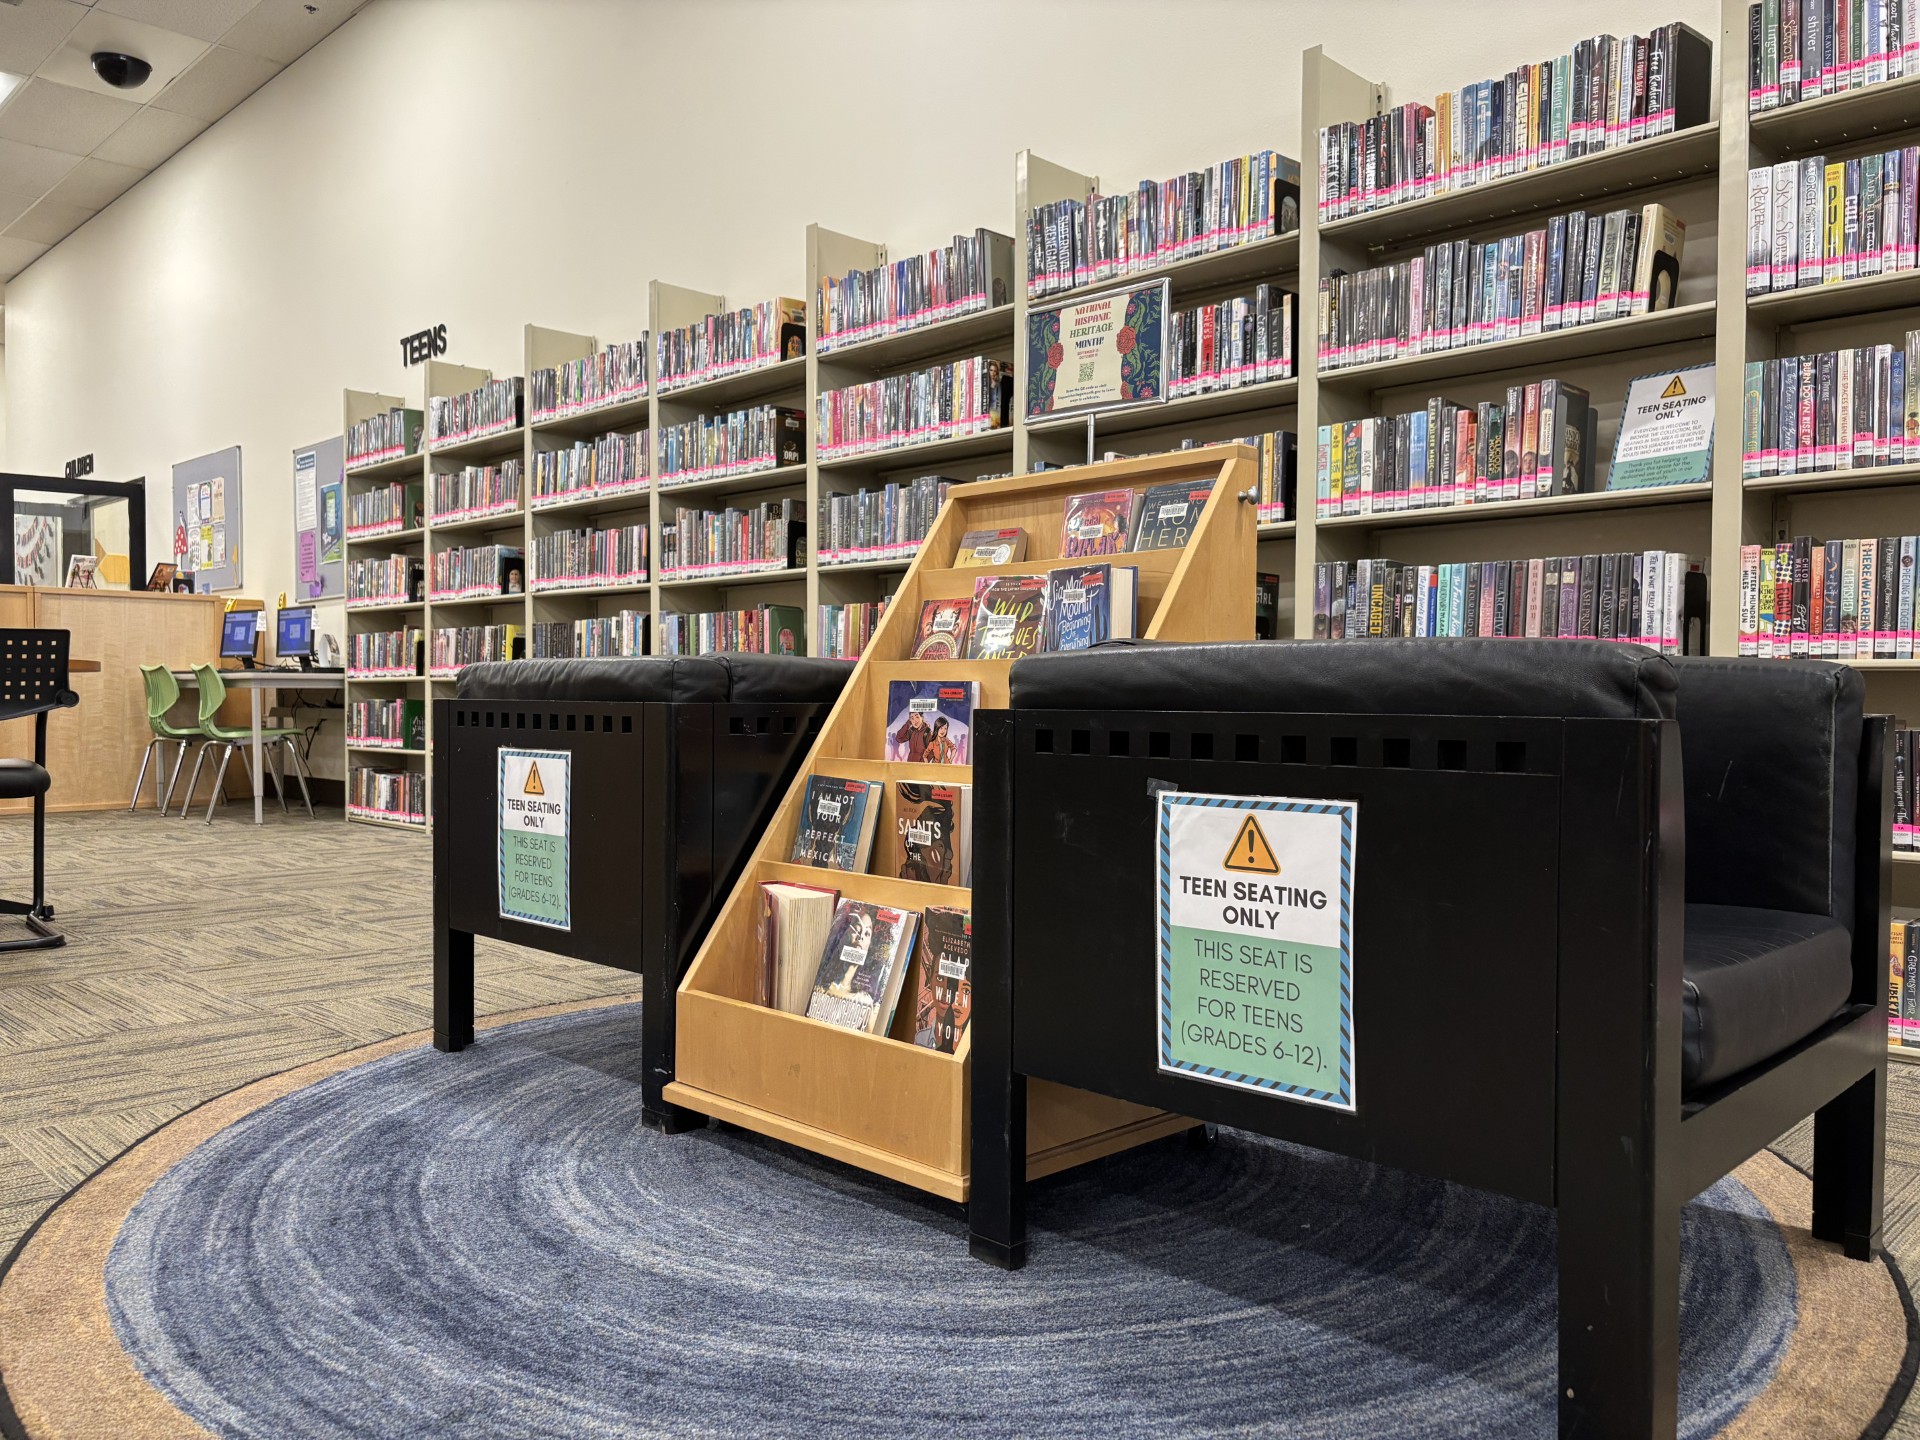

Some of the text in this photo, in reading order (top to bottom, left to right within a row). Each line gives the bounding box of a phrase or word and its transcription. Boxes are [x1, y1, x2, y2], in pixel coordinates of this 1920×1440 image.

[1752, 7, 1760, 46] LAMENT
[1807, 16, 1819, 51] shiver
[1764, 24, 1778, 58] linger
[1648, 49, 1663, 113] Free Radicals
[1776, 180, 1793, 208] SKY
[1865, 172, 1874, 200] JADE
[1750, 186, 1768, 229] REAPER
[1058, 216, 1070, 270] SUPERNOVA
[1486, 249, 1495, 288] YOUR FAULT
[1075, 301, 1112, 316] NATIONAL
[1075, 312, 1111, 326] HISPANIC
[1070, 322, 1114, 338] HERITAGE
[400, 323, 447, 368] TEENS
[1075, 336, 1104, 350] MONTH!
[1637, 396, 1707, 415] TEEN SEATING
[1655, 409, 1683, 420] ONLY
[1802, 362, 1811, 445] BURN DOWN. RISE UP
[1148, 501, 1161, 509] WE
[1138, 528, 1188, 548] HER
[1862, 549, 1873, 580] HERE
[1451, 576, 1462, 615] The Future
[1583, 588, 1592, 606] ASH
[1843, 569, 1855, 611] CHERISHED
[1900, 568, 1911, 607] PIECING ME
[1370, 584, 1383, 634] UNCAGED
[1602, 589, 1613, 614] LADY
[1776, 588, 1792, 616] FUGLY
[1058, 614, 1091, 639] Beginning
[1793, 617, 1800, 625] 13
[811, 790, 855, 806] I AM NOT
[1894, 775, 1905, 800] Hunger
[507, 799, 561, 814] TEEN SEATING
[815, 811, 842, 824] YOUR
[523, 815, 544, 828] ONLY
[513, 836, 556, 853] THIS SEAT IS
[805, 829, 846, 844] PERFECT
[906, 839, 914, 848] OF
[516, 854, 552, 870] RESERVED
[800, 848, 842, 864] MEXICAN
[909, 852, 921, 862] THE
[515, 871, 553, 887] FOR TEENS
[508, 887, 561, 910] (GRADES 6-12).
[1179, 875, 1328, 910] TEEN SEATING
[1222, 905, 1280, 930] ONLY
[942, 935, 971, 949] ELIZABETH
[943, 944, 968, 955] ACEVEDO
[1193, 938, 1313, 974] THIS SEAT IS
[1200, 968, 1301, 1002] RESERVED
[1907, 955, 1918, 993] GREYMIST
[935, 986, 968, 1008] WHEN
[807, 992, 873, 1032] SHADOWSHAPER
[1198, 996, 1304, 1034] FOR TEENS
[937, 1023, 959, 1042] YOU
[1180, 1020, 1328, 1073] (GRADES 6-12).
